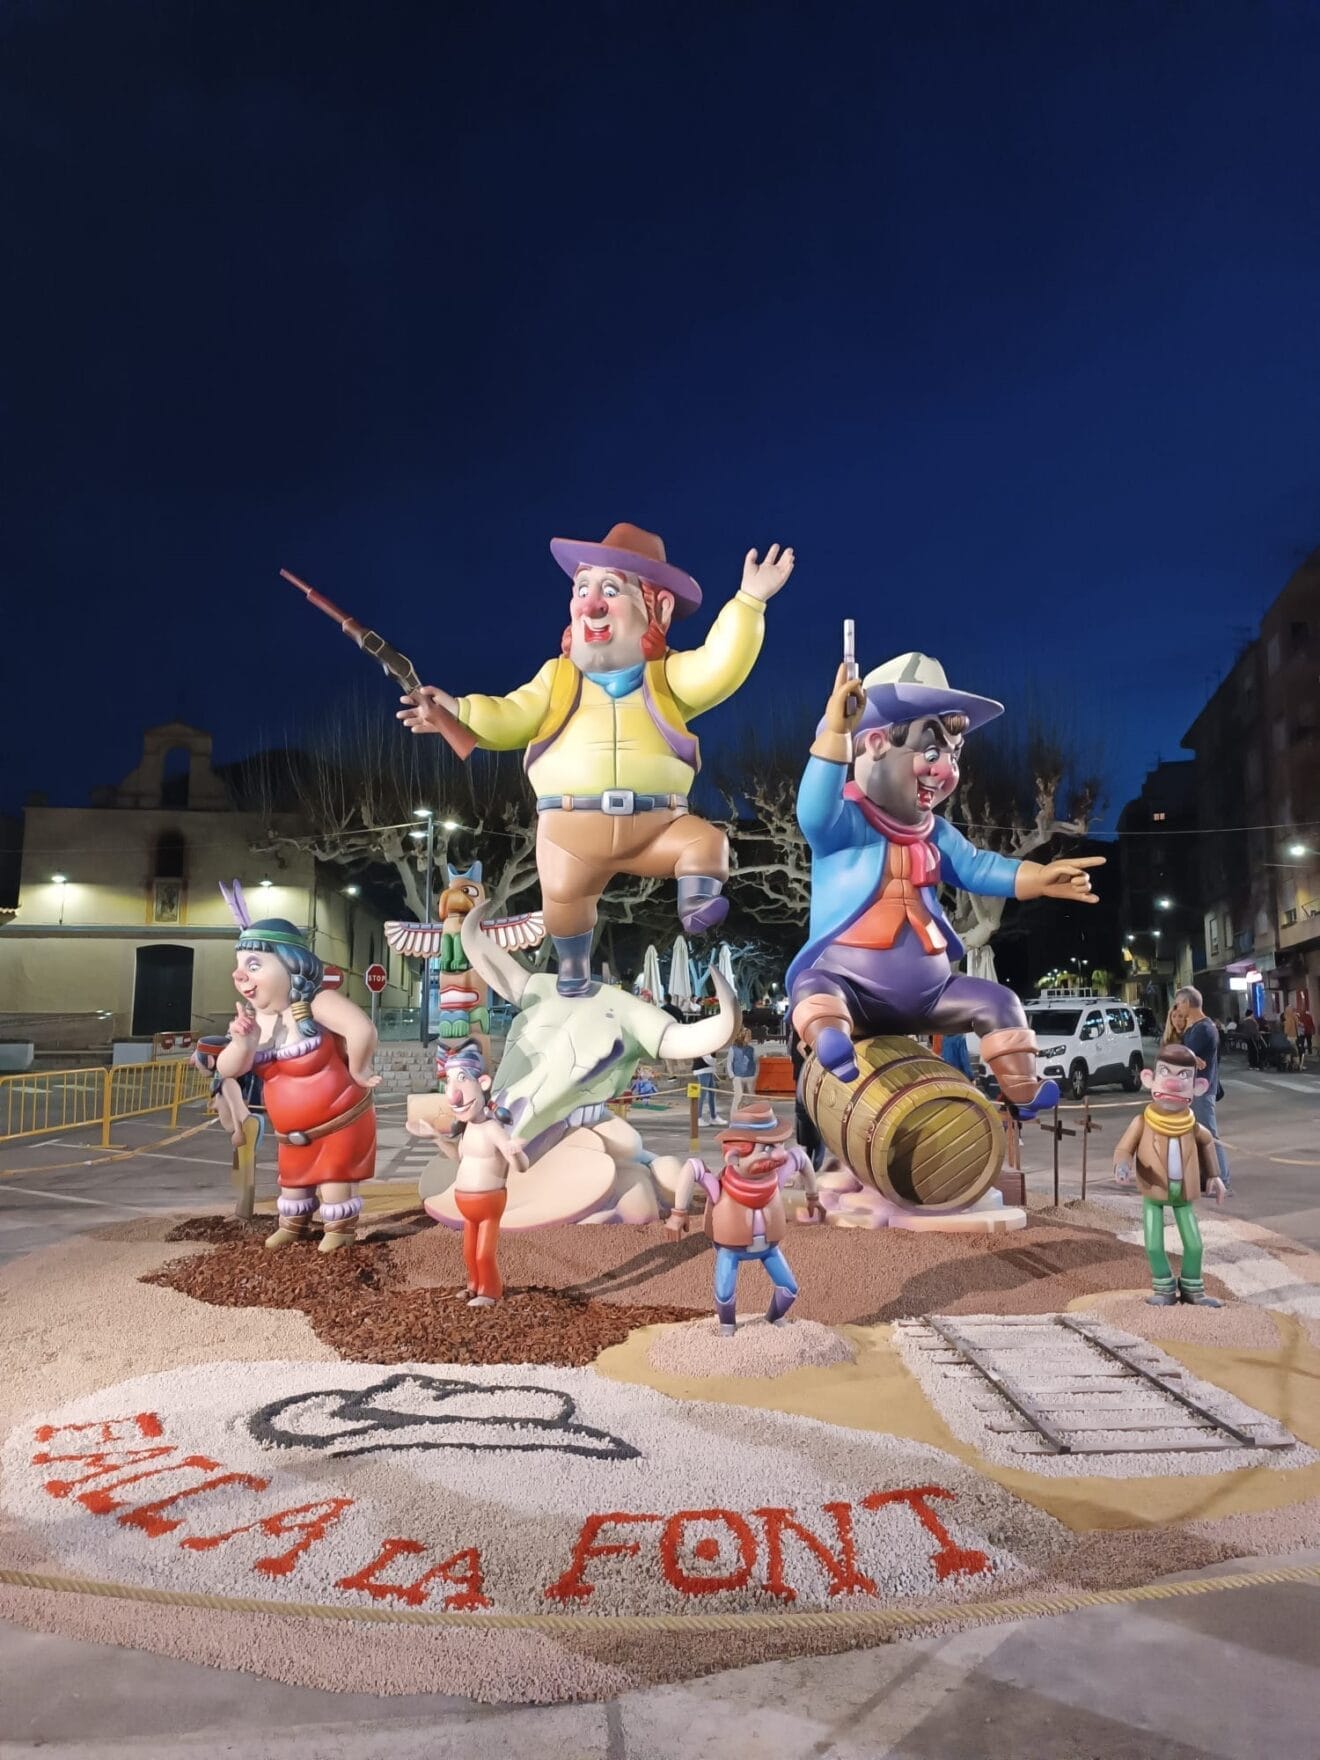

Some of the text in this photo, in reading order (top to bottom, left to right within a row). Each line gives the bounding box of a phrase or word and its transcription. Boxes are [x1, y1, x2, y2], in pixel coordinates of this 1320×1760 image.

[368, 974, 386, 983] STOP
[33, 1412, 988, 1613] FALLA LA FONT
